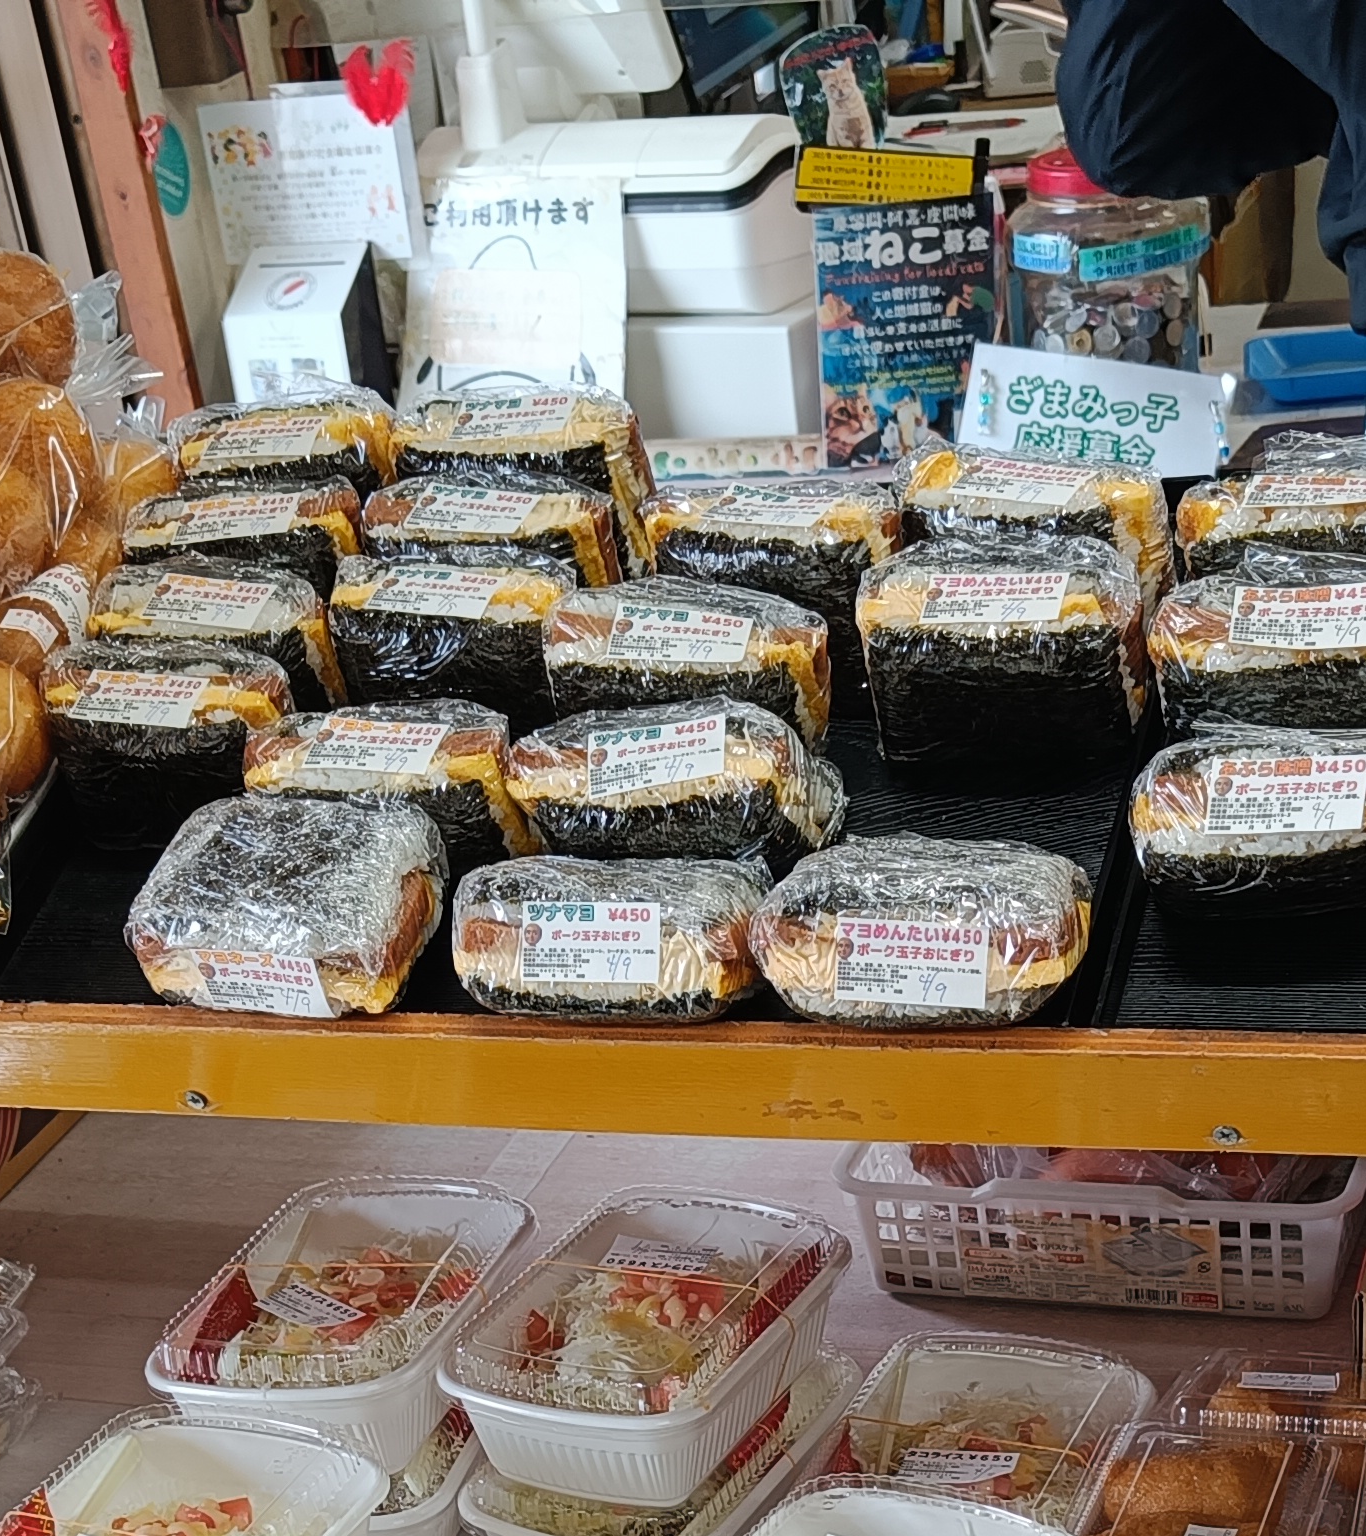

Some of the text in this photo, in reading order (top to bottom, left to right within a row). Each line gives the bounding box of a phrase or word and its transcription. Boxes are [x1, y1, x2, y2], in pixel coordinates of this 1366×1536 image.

[424, 197, 594, 228] ご利用頂けます
[465, 396, 568, 411] ツナマヨ ¥450
[1007, 375, 1179, 433] ざまみっ子
[480, 409, 556, 422] ポーク玉子おにぎり
[1014, 421, 1155, 465] 応援募金
[261, 496, 294, 506] ¥450
[442, 500, 518, 515] ポーク玉子おにぎり
[496, 494, 533, 505] ¥450
[196, 504, 288, 521] ポーク玉子おにぎり
[167, 574, 269, 596] マヨネーズ ¥450
[405, 580, 480, 594] ポーク玉子おにぎり
[460, 575, 498, 586] ¥450
[933, 575, 1063, 588] マヨめんたい ¥450
[172, 586, 261, 604] ポーク玉子おにぎり
[946, 586, 1054, 599] ポーク玉子おにぎり
[1242, 587, 1331, 603] あぶら味噌
[622, 605, 744, 629] ツナマヨ ¥450
[642, 624, 730, 638] ポーク玉子おにぎり
[95, 671, 201, 690] マヨネーズ ¥450
[101, 685, 193, 699] ポーク玉子おにぎり
[328, 718, 441, 736] マヨネーズ ¥450
[593, 719, 718, 745] ツナマヨ ¥450
[335, 733, 433, 746] ポーク玉子おにぎり
[617, 737, 707, 758] ポーク玉子おにぎり
[1219, 758, 1366, 777] あぶら味噌 ¥450
[1235, 779, 1358, 795] ポーク玉子おにぎり
[528, 903, 651, 923] ツナマヨ ¥450
[552, 929, 641, 942] ポーク玉子おにぎり
[840, 921, 983, 945] マヨめんたい ¥450
[857, 944, 975, 963] ポーク玉子おにぎり
[195, 951, 312, 974] マヨネーズ ¥450
[218, 968, 314, 987] ポーク玉子おにぎり
